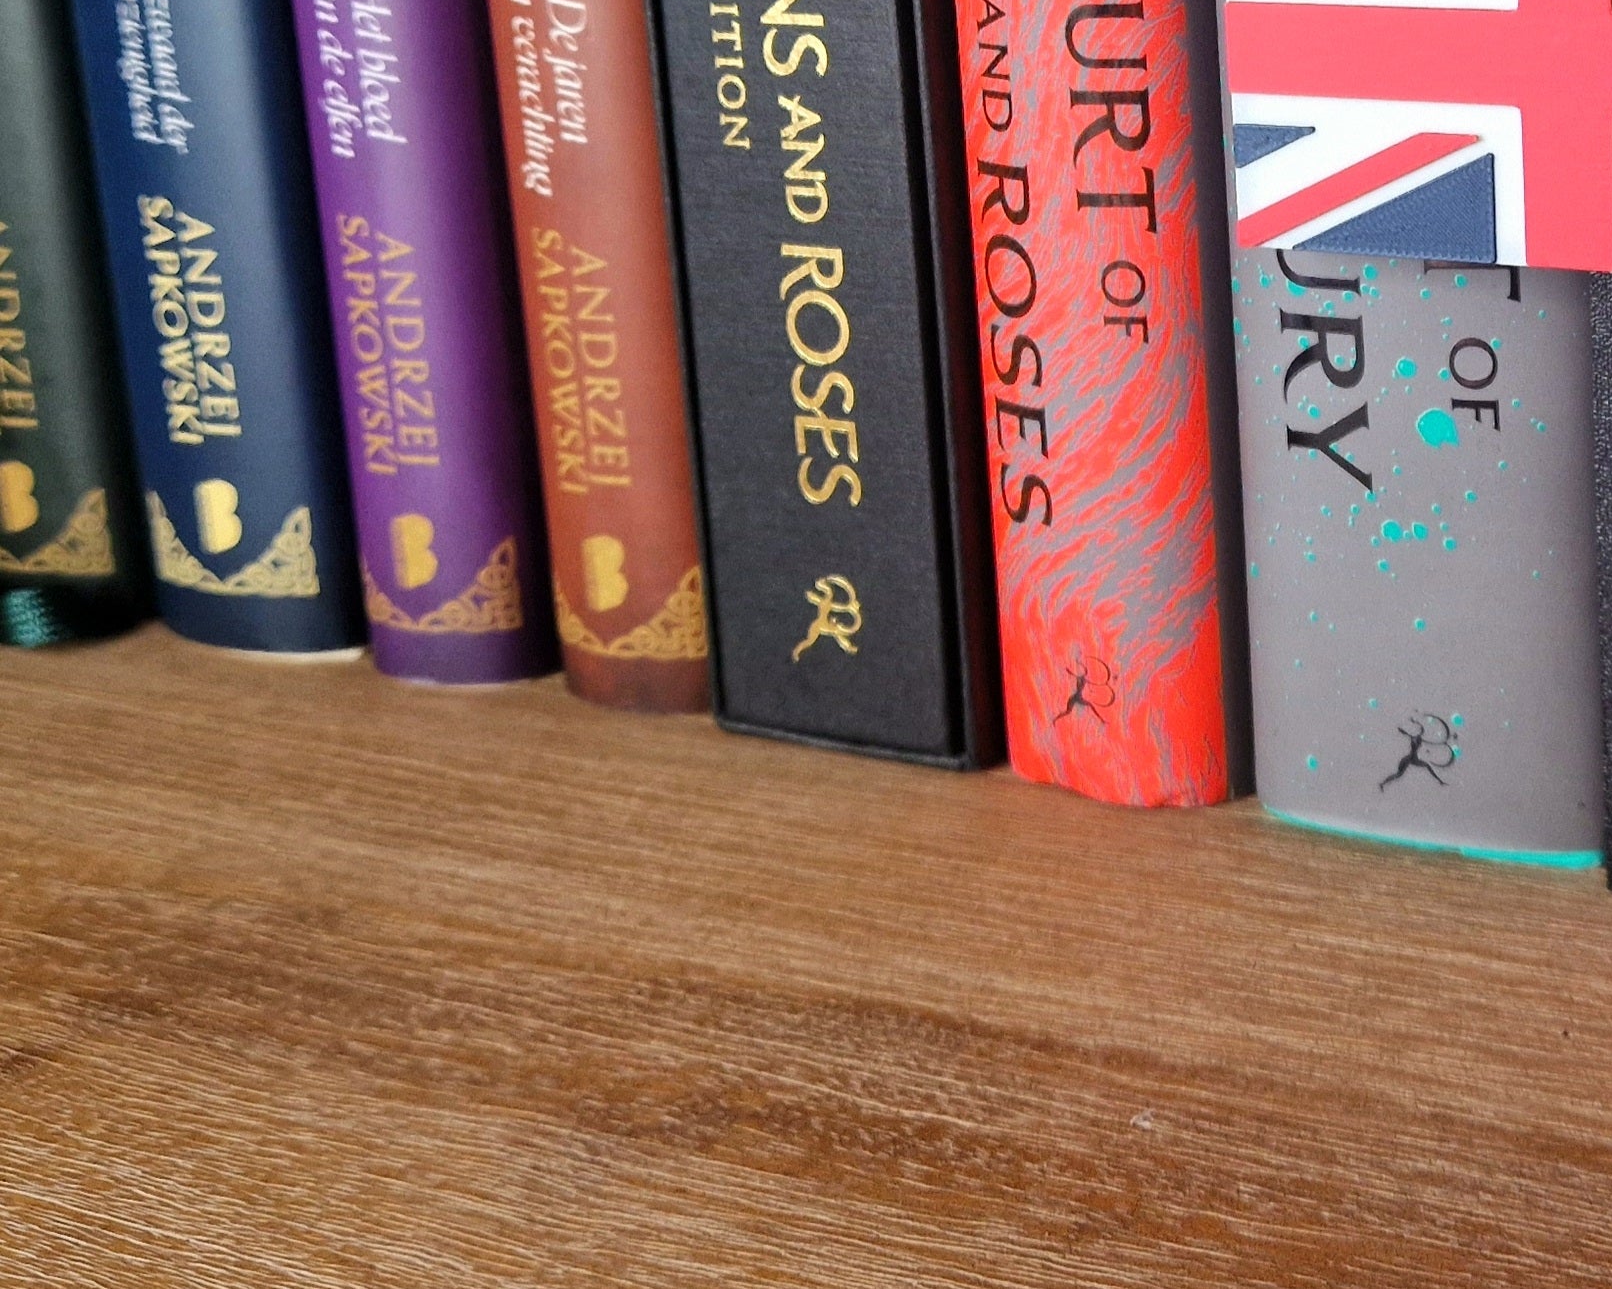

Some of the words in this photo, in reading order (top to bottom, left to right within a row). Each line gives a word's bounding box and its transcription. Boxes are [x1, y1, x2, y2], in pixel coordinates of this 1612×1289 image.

[317, 28, 354, 77] de
[356, 47, 409, 144] bloed
[543, 47, 589, 145] jaren
[319, 79, 363, 159] elfen
[778, 93, 830, 224] AND
[137, 194, 206, 446] SAPKOWSKI
[336, 214, 398, 476] SAPKOWSKI
[977, 158, 1053, 529] ROSES
[1100, 259, 1149, 346] OF
[531, 227, 590, 495] SAPKOWSKI
[779, 243, 862, 508] ROSES
[1448, 336, 1502, 433] OF
